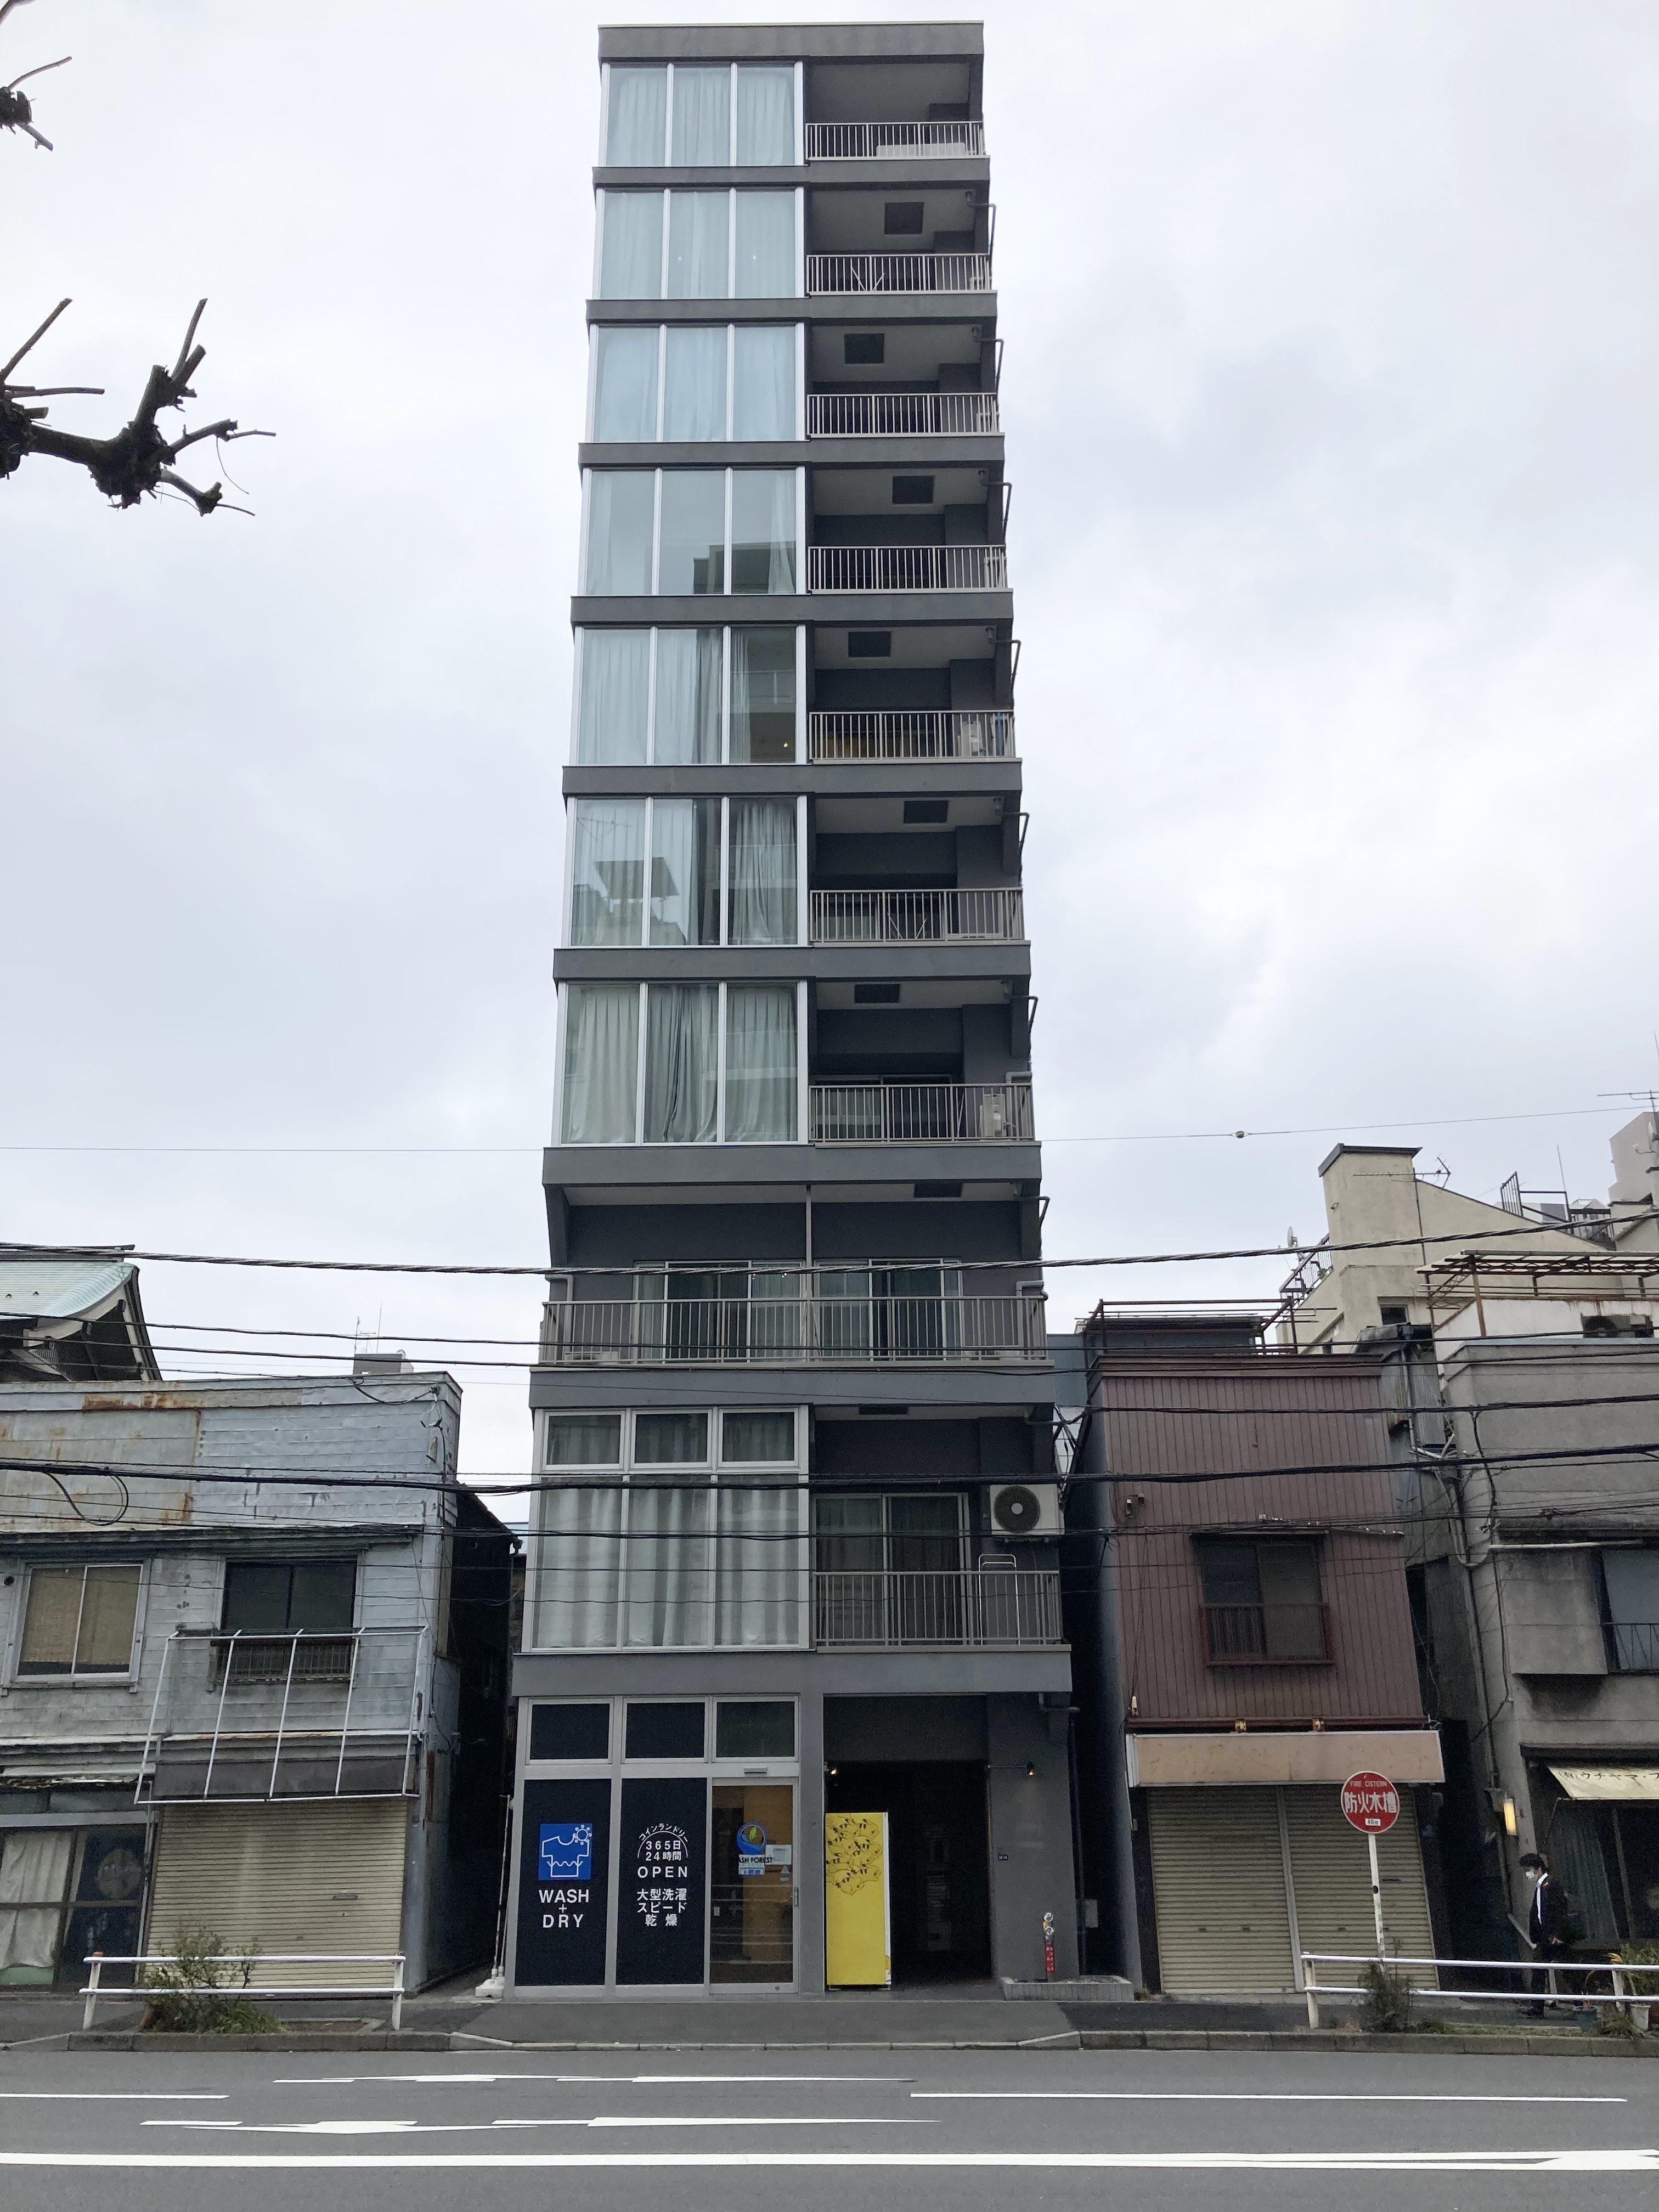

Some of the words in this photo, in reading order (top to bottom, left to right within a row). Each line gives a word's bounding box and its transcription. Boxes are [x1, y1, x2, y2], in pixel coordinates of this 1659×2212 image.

[639, 1823, 688, 1842] コインランドリー
[646, 1840, 681, 1850] 365日
[645, 1851, 681, 1861] 24時間
[637, 1866, 687, 1878] OPEN
[539, 1889, 589, 1903] WASH
[637, 1888, 687, 1901] 大型洗濯
[637, 1901, 687, 1914] スピード
[543, 1914, 584, 1928] DRY
